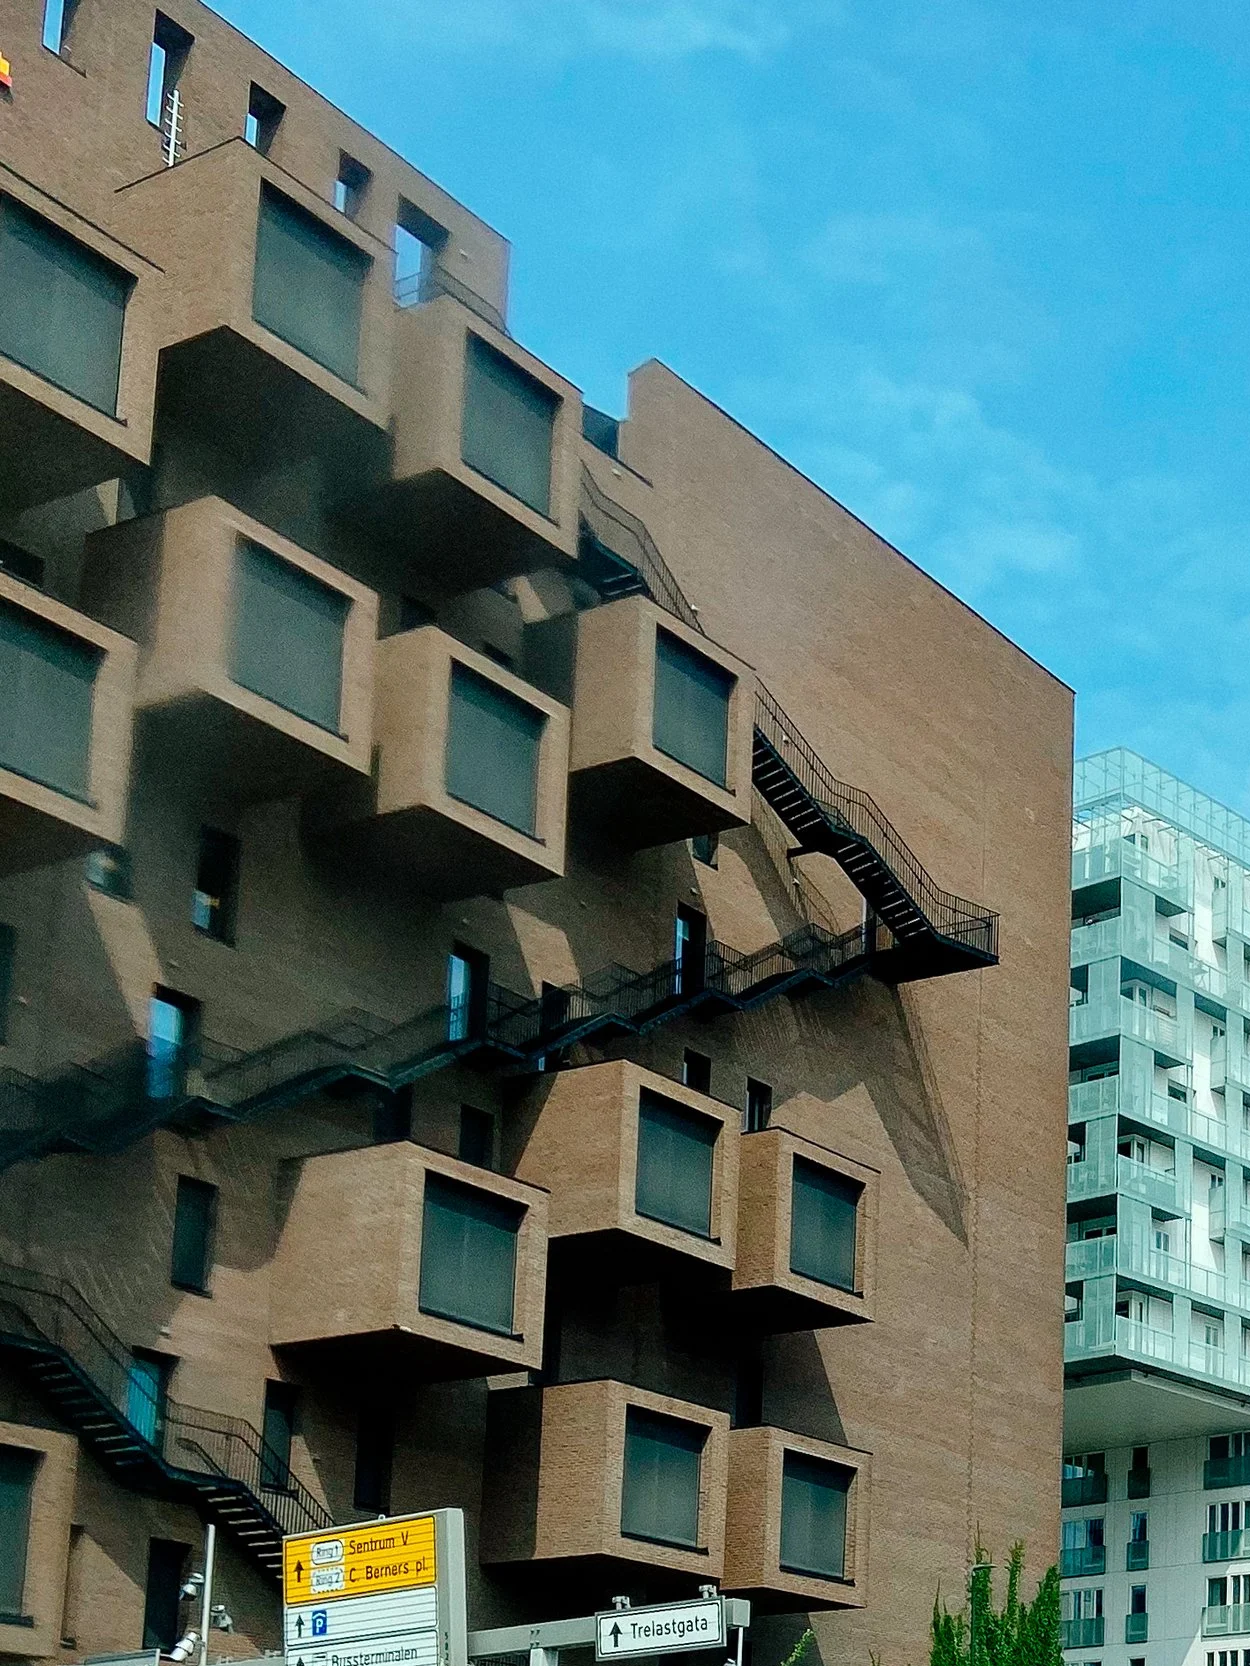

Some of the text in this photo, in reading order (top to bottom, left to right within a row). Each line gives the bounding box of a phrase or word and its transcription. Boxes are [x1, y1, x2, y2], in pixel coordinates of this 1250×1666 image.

[316, 1547, 333, 1559] Ring
[349, 1531, 409, 1556] Sentrum V
[315, 1571, 340, 1588] Ring 2
[349, 1567, 360, 1583] C.
[365, 1562, 409, 1580] Berners
[630, 1615, 708, 1639] Trelastgata
